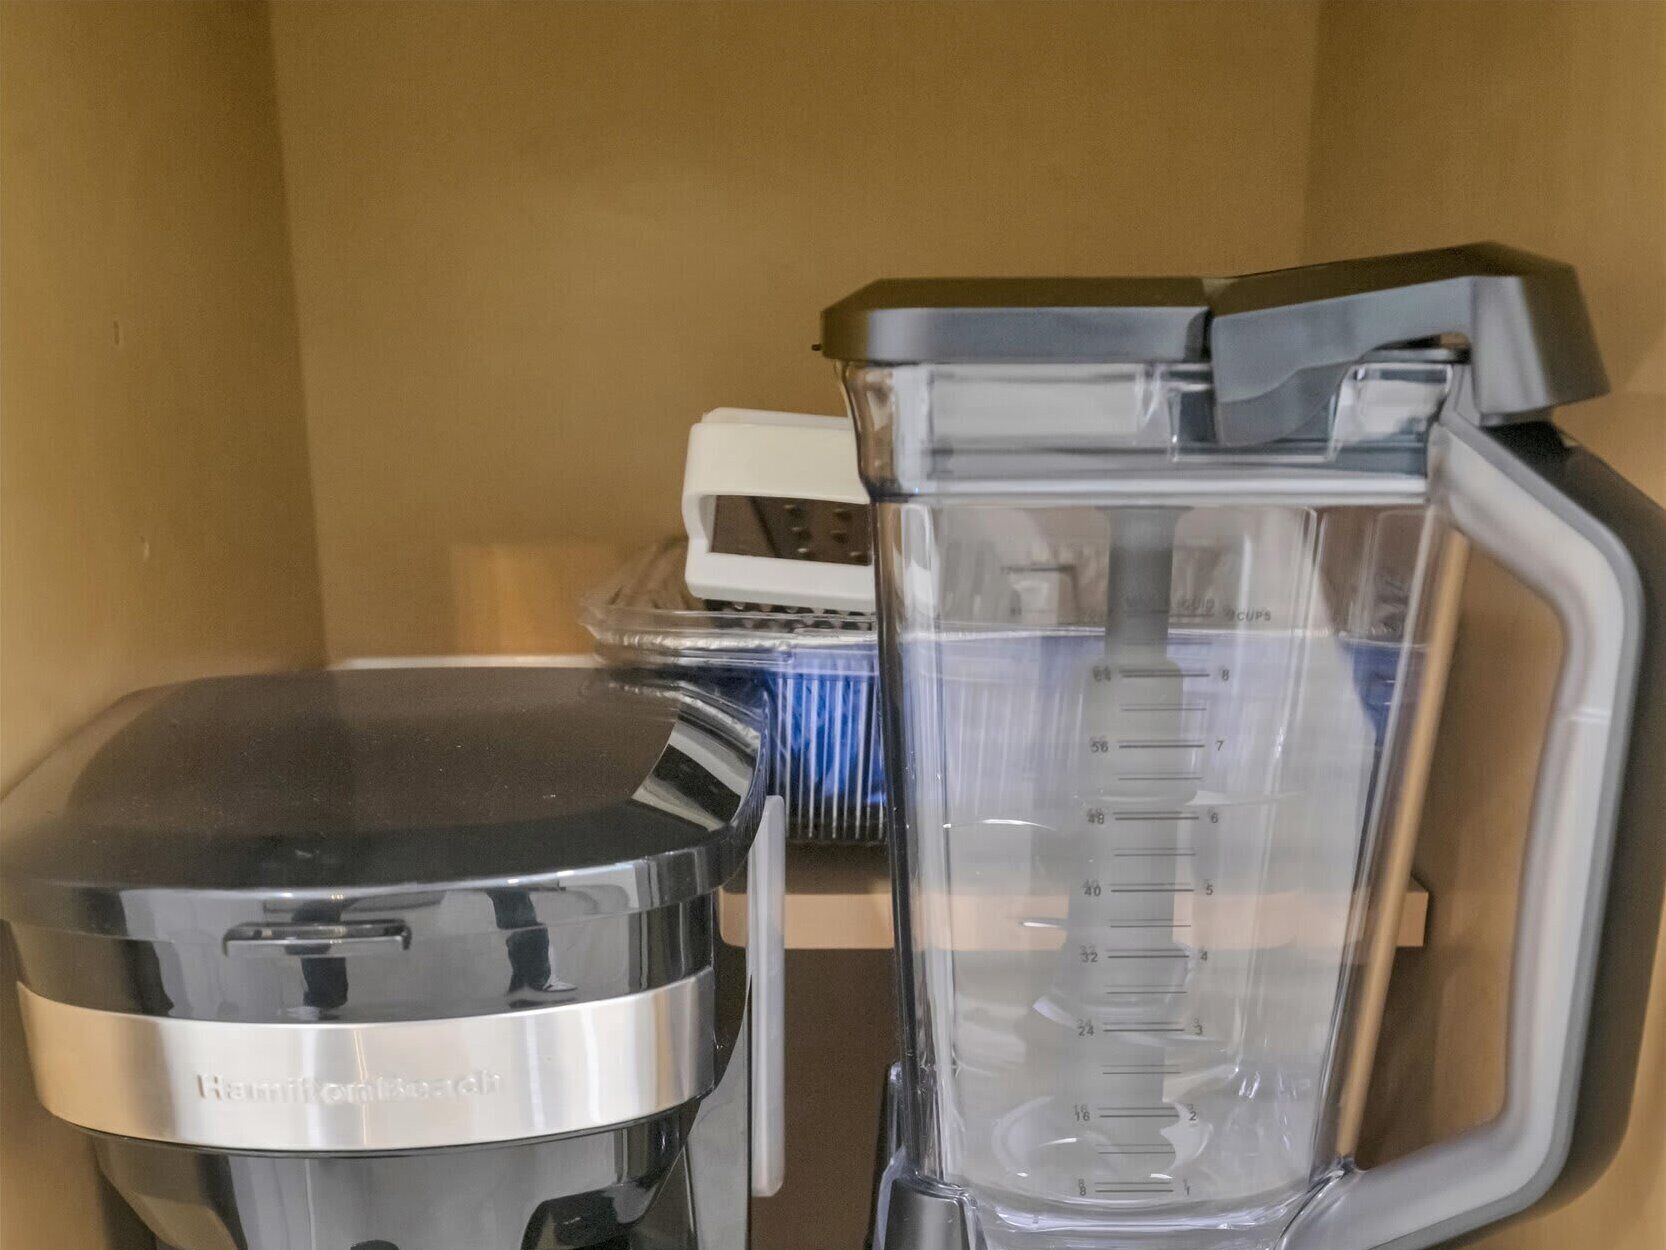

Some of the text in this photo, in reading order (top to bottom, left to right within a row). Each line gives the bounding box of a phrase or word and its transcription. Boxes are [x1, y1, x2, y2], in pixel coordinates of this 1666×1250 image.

[1236, 609, 1271, 622] CUPS
[1090, 740, 1109, 753] 56
[1216, 740, 1224, 751] 7
[1210, 812, 1219, 824] 6
[1084, 885, 1102, 897] 40
[1206, 885, 1214, 896] 5
[1081, 951, 1098, 963] 32
[1200, 951, 1208, 962] 4
[1078, 1025, 1095, 1037] 24
[1075, 1110, 1090, 1122] 16
[1189, 1110, 1198, 1122] 2
[1079, 1185, 1087, 1196] 8
